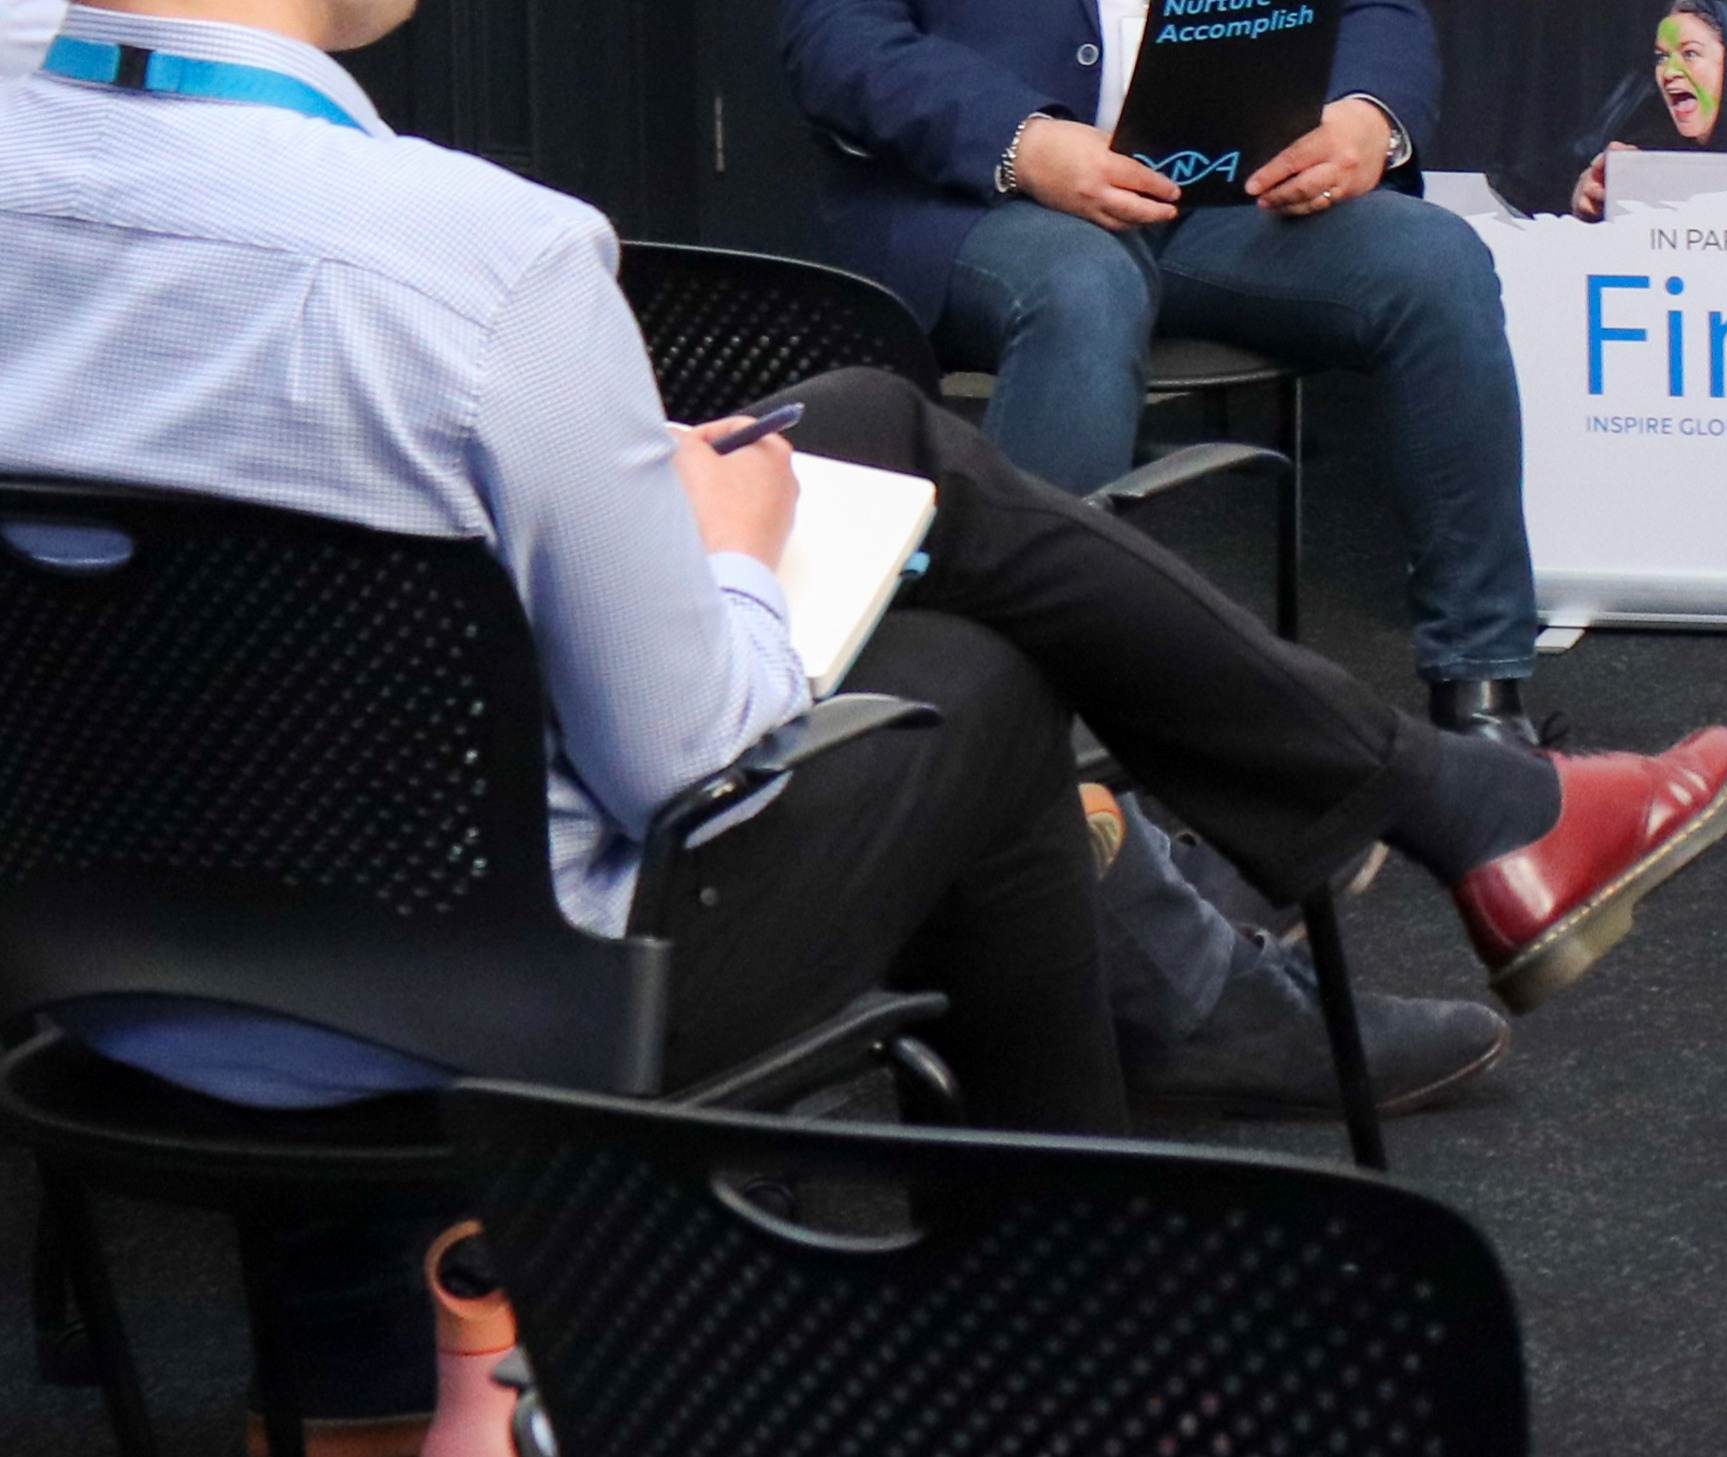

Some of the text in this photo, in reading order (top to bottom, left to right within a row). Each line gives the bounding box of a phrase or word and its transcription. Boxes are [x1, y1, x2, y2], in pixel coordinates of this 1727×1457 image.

[1155, 4, 1315, 44] Accomplish
[1650, 228, 1677, 250] IN
[1587, 416, 1673, 434] INSPIRE
